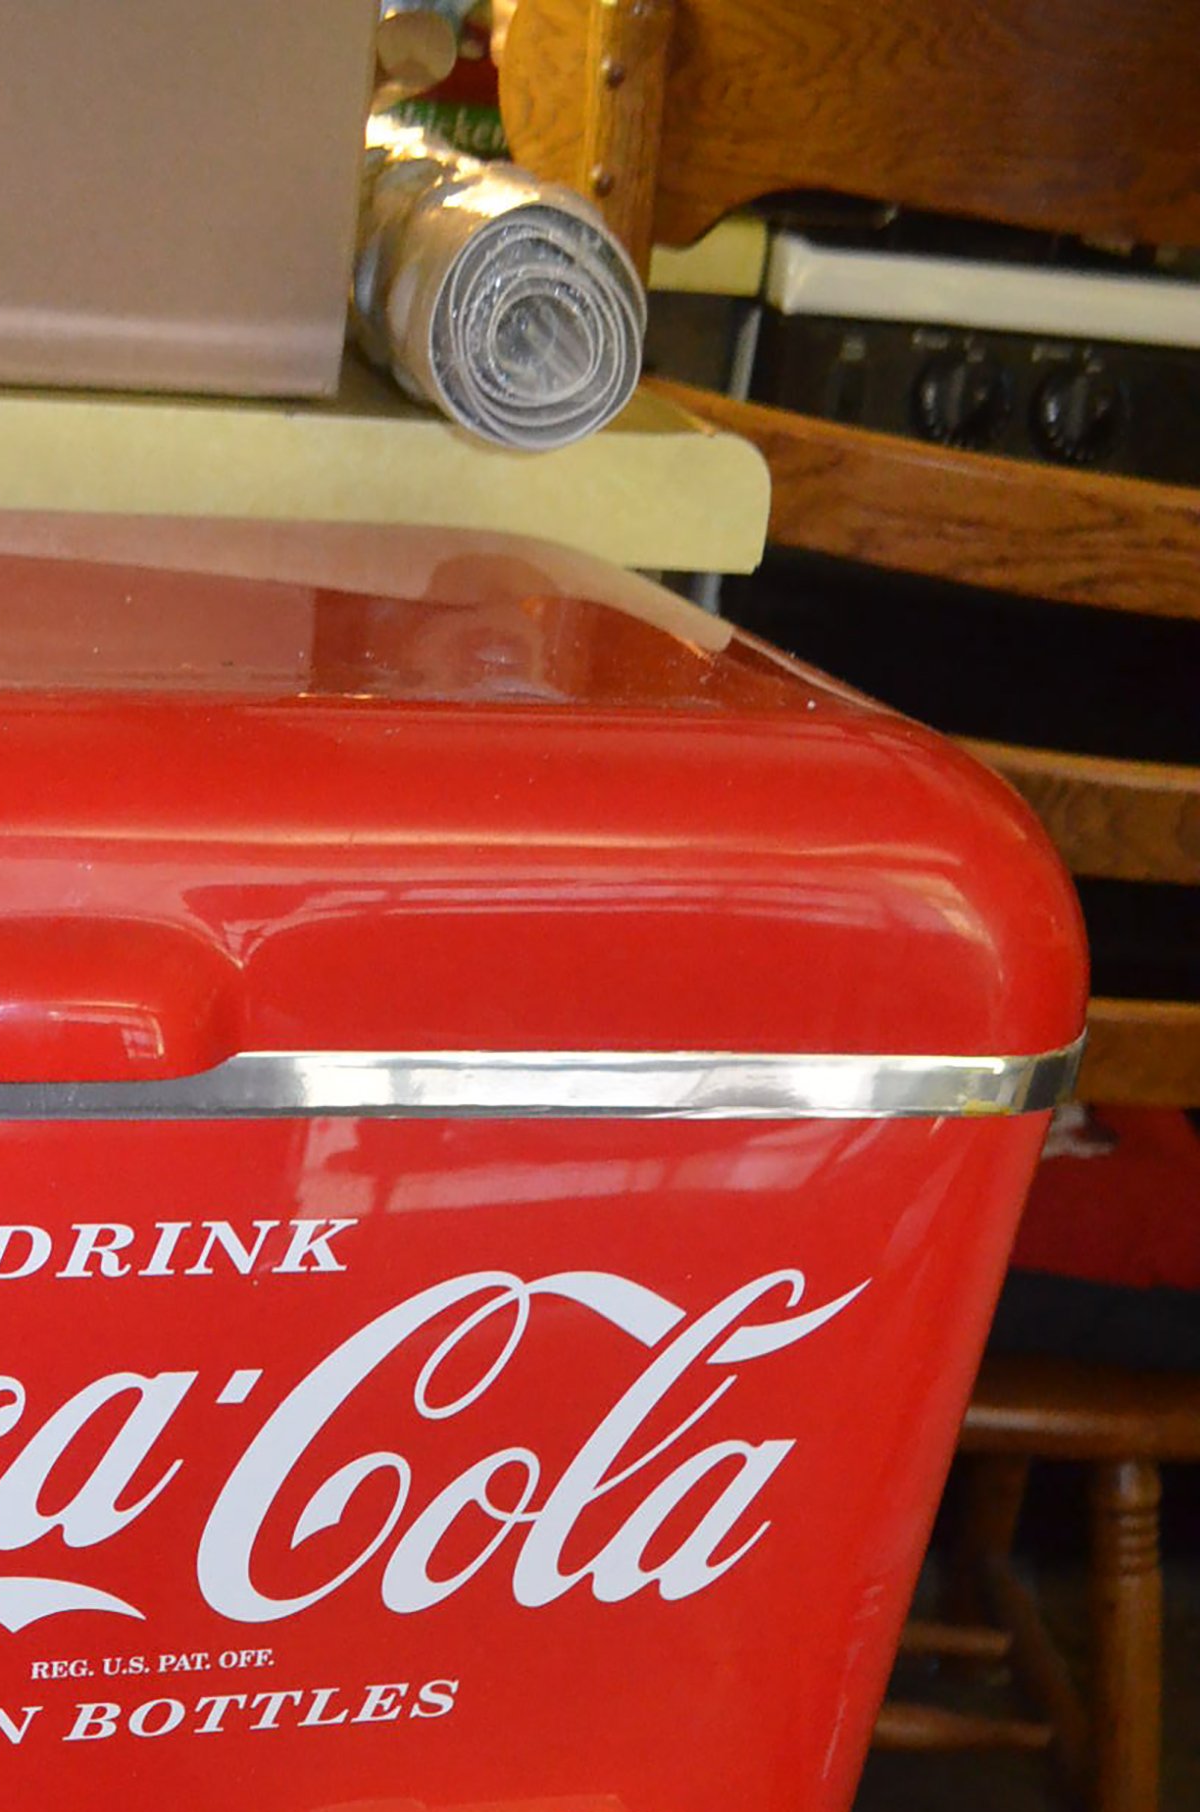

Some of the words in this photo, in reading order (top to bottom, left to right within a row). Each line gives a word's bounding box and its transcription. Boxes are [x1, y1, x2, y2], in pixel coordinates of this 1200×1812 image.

[30, 1659, 95, 1680] REG.
[102, 1656, 150, 1676] U.S.
[157, 1652, 211, 1673] PAT.
[218, 1648, 275, 1669] OFF.
[61, 1679, 460, 1742] BOTTLES
